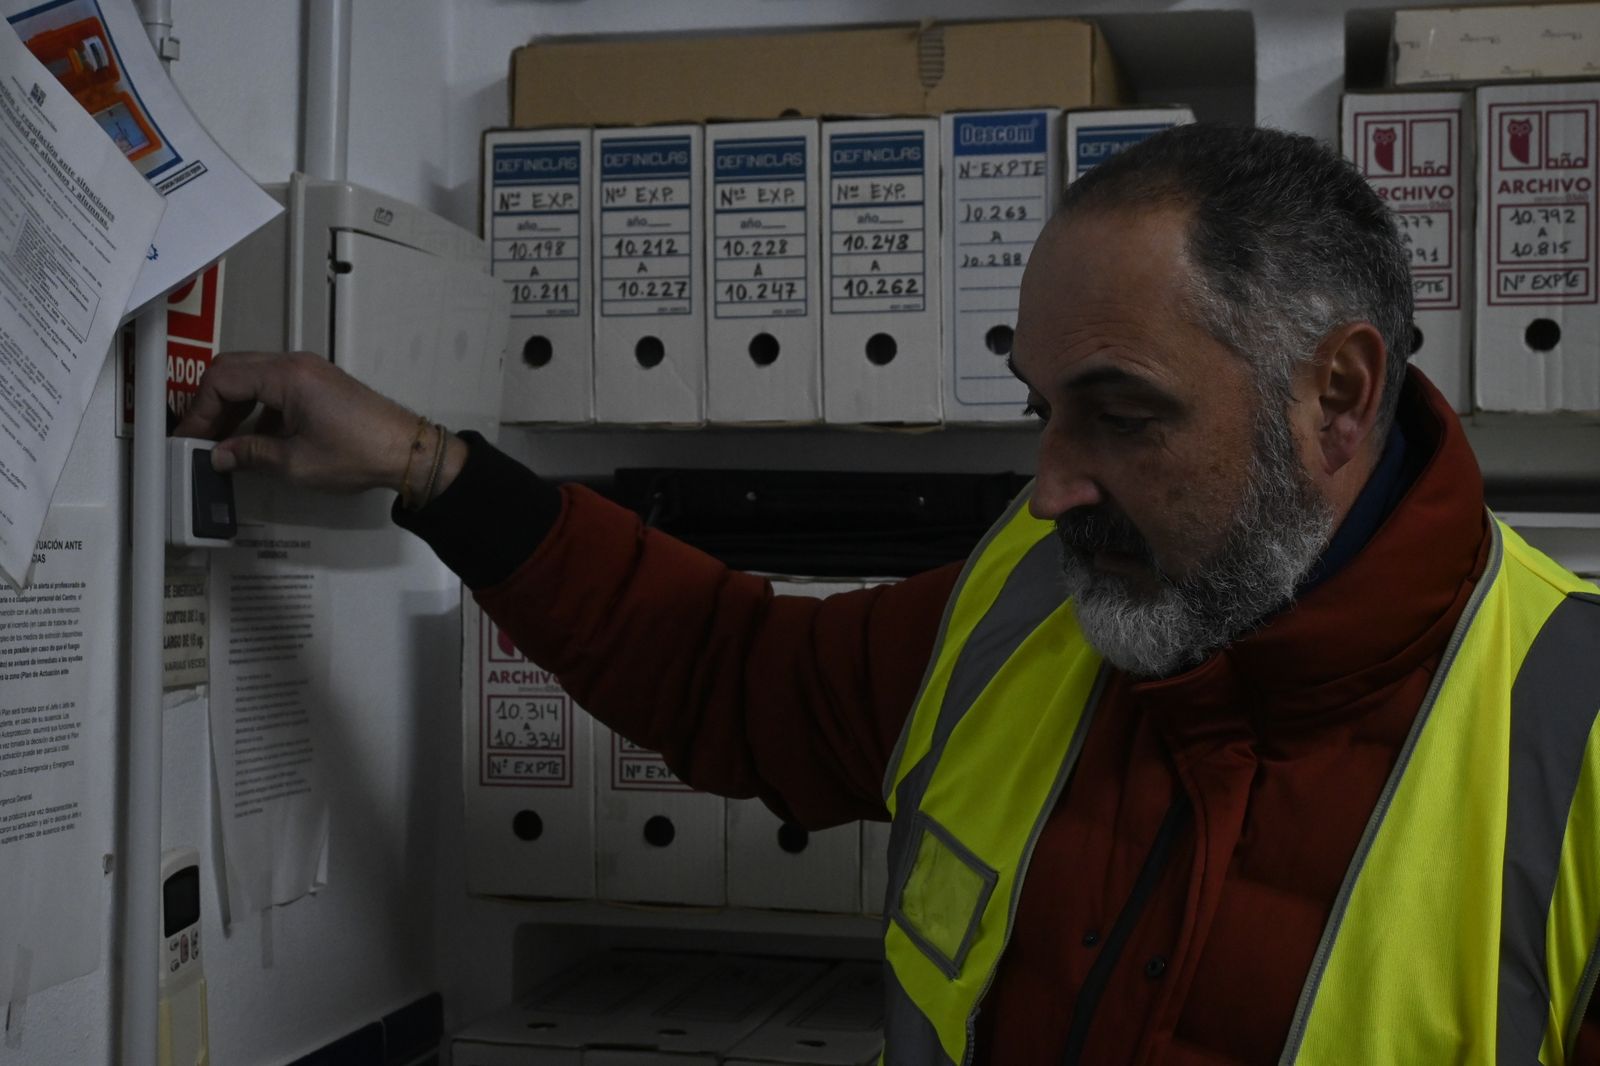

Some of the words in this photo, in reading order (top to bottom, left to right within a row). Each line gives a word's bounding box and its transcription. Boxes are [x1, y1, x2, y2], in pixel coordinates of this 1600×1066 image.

[960, 123, 1035, 146] Descom
[603, 151, 688, 168] DEFINICLAS
[717, 153, 802, 170] DEFINICLAS
[833, 147, 921, 163] DEFINICLAS
[19, 110, 61, 158] regulación
[75, 174, 117, 223] situaciones
[38, 148, 72, 186] alumnos
[495, 157, 577, 173] DEFINICLAS
[1377, 185, 1454, 200] RCHIVO
[1498, 177, 1591, 194] ARCHIVO
[627, 217, 647, 228] año
[741, 218, 761, 229] año
[857, 214, 878, 224] año
[1510, 209, 1576, 225] 10.792
[517, 221, 538, 231] año
[1538, 227, 1547, 237] A
[509, 240, 565, 260] 10.198
[615, 238, 677, 256] 10.212
[724, 239, 788, 256] 10.228
[844, 234, 909, 251] 10.248
[530, 265, 539, 277] A
[637, 261, 648, 273] A
[754, 262, 763, 276] A
[871, 259, 880, 271] A
[844, 278, 918, 297] 10.262
[1531, 271, 1579, 290] EXPTE
[512, 283, 569, 301] 10.211
[619, 281, 687, 299] 10.227
[726, 283, 797, 301] 10.247
[65, 541, 82, 550] ANTE
[495, 701, 558, 720] 10.314
[523, 722, 531, 731] A
[495, 729, 560, 747] 10.334
[514, 761, 560, 774] EXPTE
